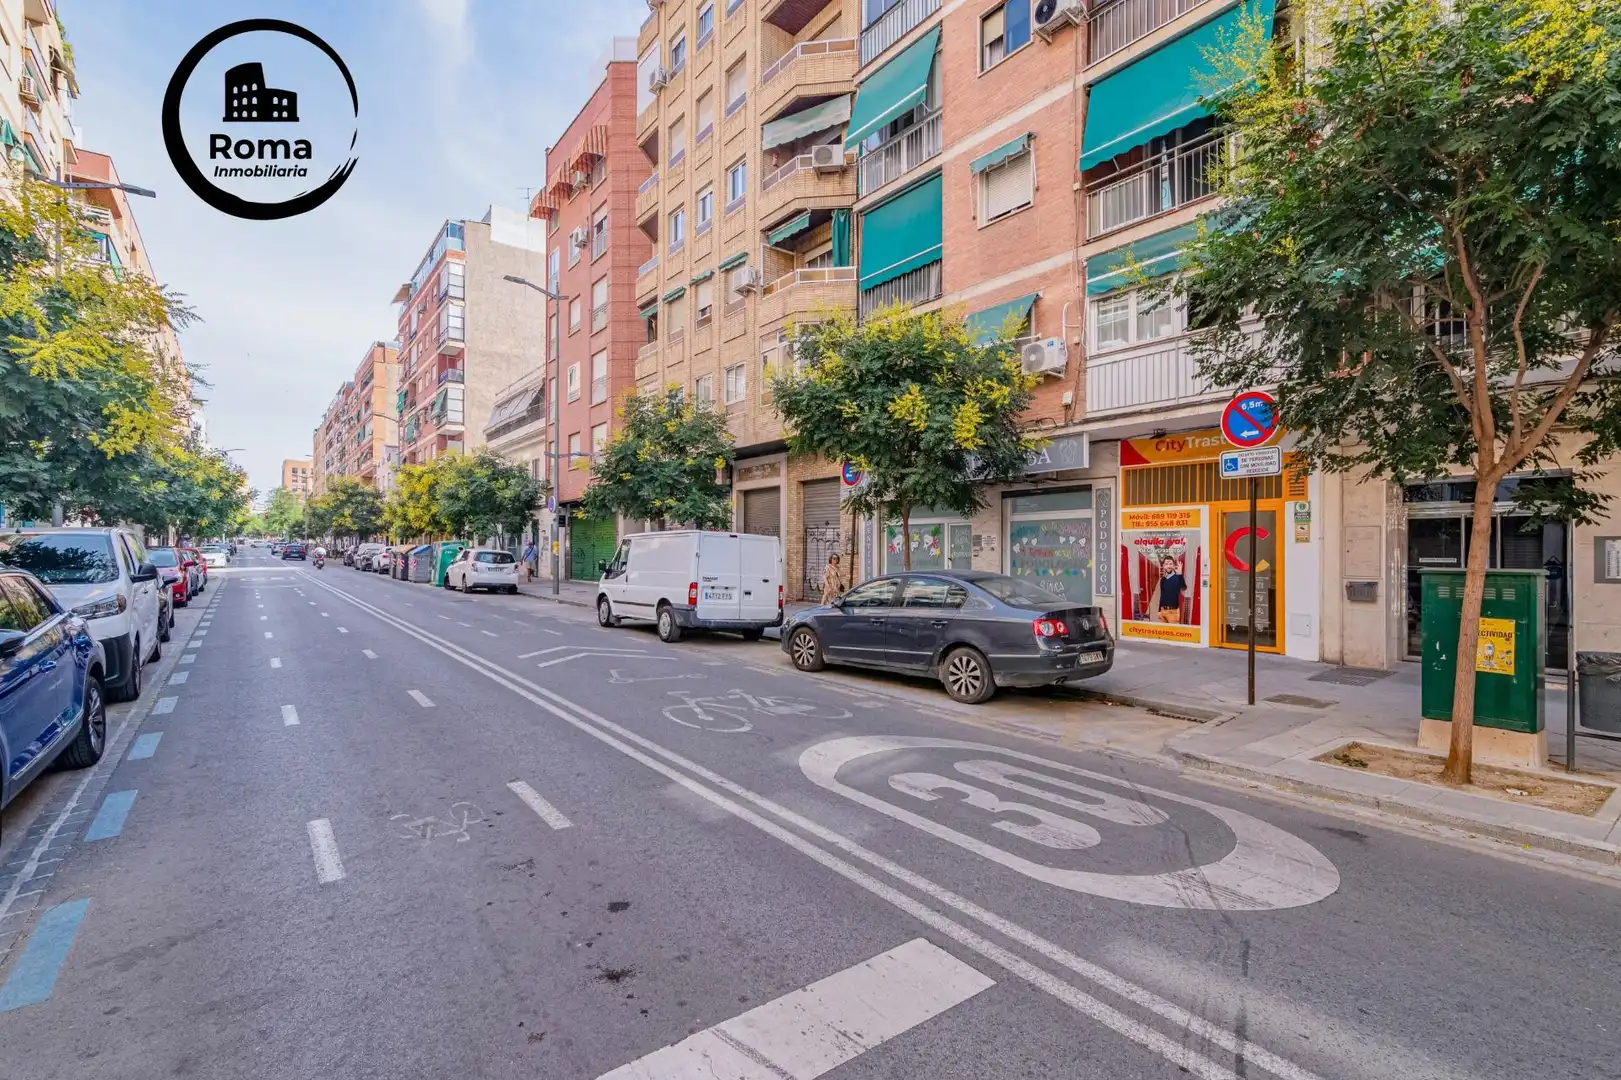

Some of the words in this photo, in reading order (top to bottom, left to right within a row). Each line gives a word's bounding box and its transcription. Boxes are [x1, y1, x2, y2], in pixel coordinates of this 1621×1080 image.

[1250, 460, 1277, 468] MOVILIDAD
[1178, 511, 1191, 519] 315
[1133, 537, 1164, 546] alquila
[1099, 509, 1108, 594] PODOLOGO
[1128, 626, 1193, 638] citytrasteros.com
[888, 760, 1170, 850] 30
